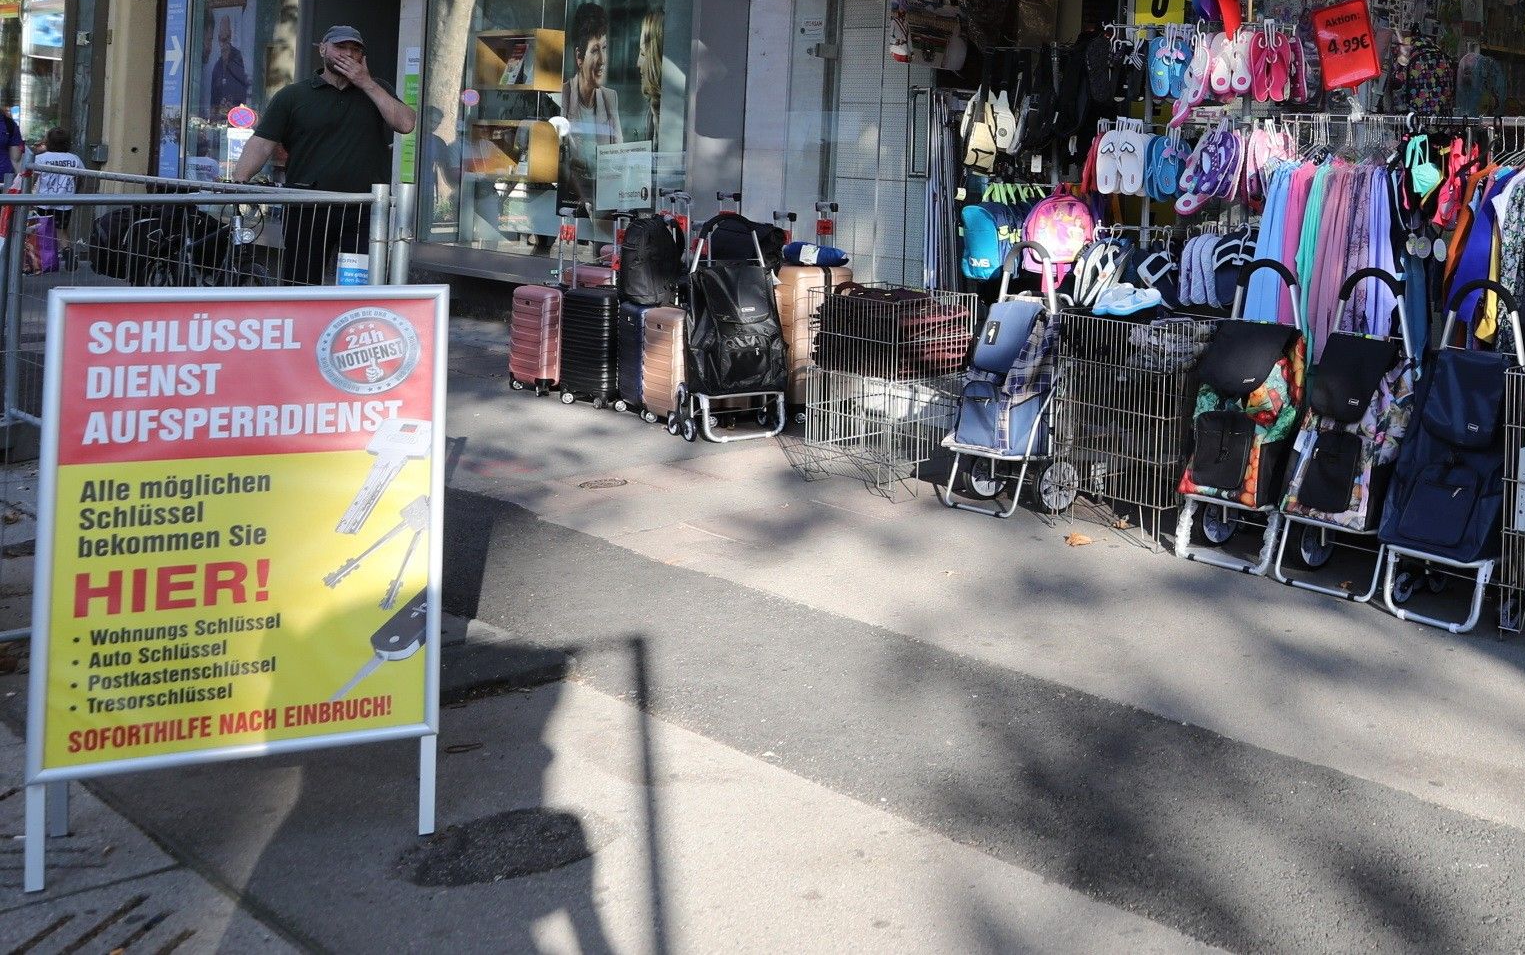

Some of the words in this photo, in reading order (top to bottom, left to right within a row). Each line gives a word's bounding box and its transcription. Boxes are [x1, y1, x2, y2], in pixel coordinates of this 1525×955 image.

[1325, 12, 1361, 29] Aktion:
[87, 312, 302, 355] SCHLÜSSEL
[345, 329, 386, 350] 24h
[335, 340, 404, 371] NOTDIENST
[86, 362, 223, 400] DIENST
[81, 399, 403, 446] AUFSPERRDIENST
[79, 478, 131, 504] Alle
[140, 473, 271, 500] möglichen
[78, 501, 205, 531] Schlüssel
[78, 530, 221, 558] bekommen
[228, 524, 268, 547] Sie
[72, 558, 271, 619] HIER!
[90, 621, 189, 647] Wohnungs
[194, 612, 282, 636] Schlüssel
[88, 646, 132, 669] Auto
[138, 639, 228, 665] Schlüssel
[87, 655, 277, 692] Postkastenschlüssel
[86, 682, 234, 715] Tresorschlüssel
[66, 714, 213, 754] SOFORTHILFE
[218, 707, 277, 736] NACH
[283, 694, 393, 729] EINBRUCH!
